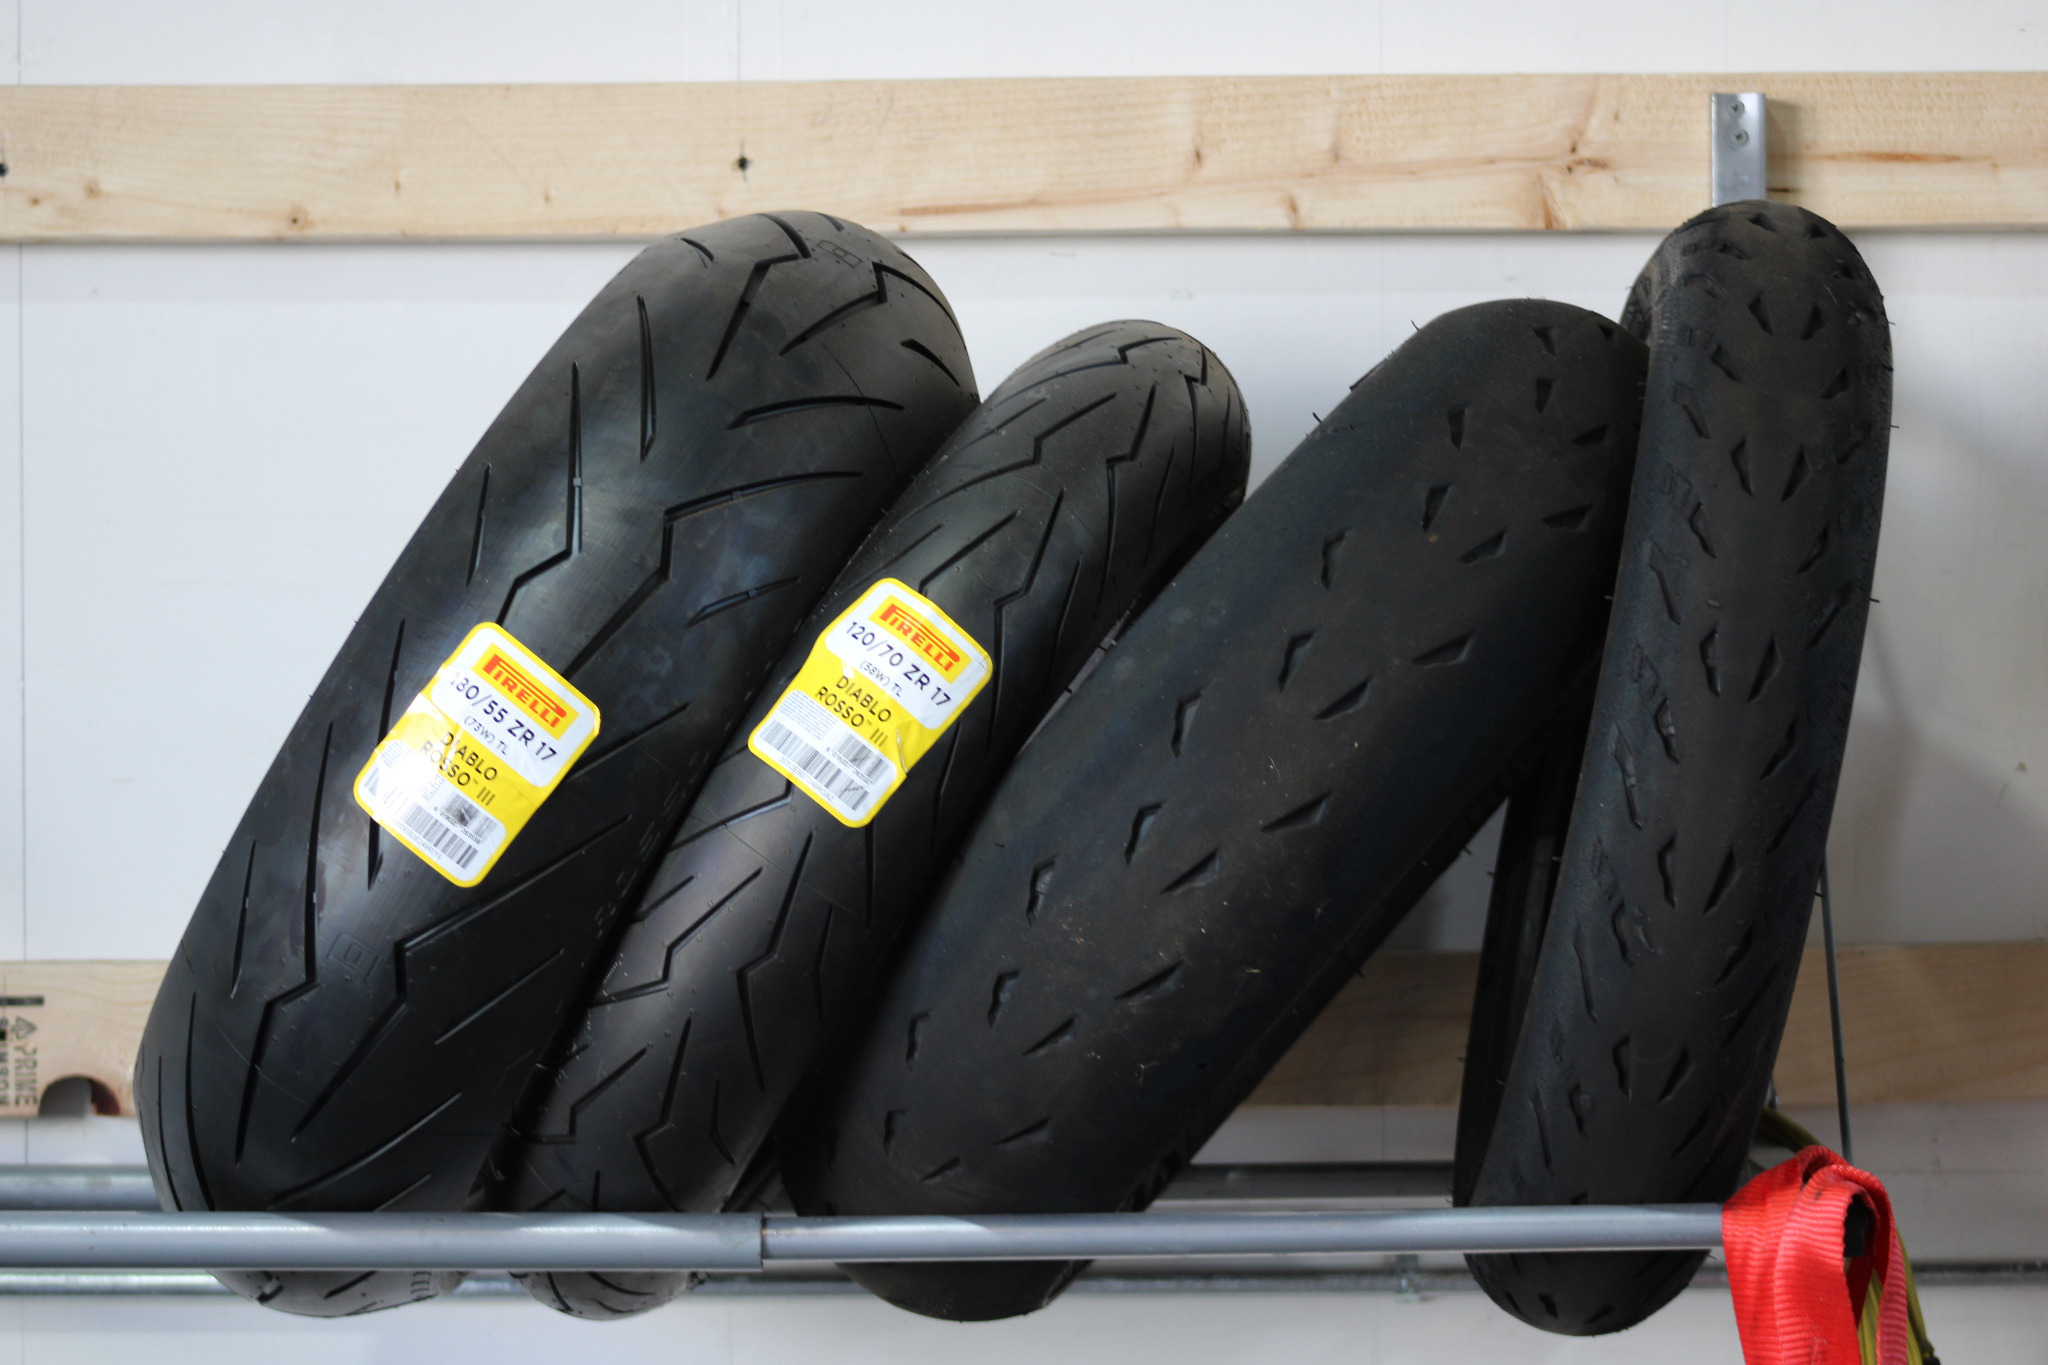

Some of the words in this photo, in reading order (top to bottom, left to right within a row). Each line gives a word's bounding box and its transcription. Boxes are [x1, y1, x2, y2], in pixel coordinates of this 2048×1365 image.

[845, 621, 904, 667] 120/70
[903, 663, 931, 692] ZR
[930, 686, 952, 708] 17
[879, 603, 960, 672] PIRELLI
[482, 654, 567, 728] PIRELLI
[835, 675, 892, 723] DIABLO
[439, 731, 498, 782] DIABLO
[507, 719, 536, 748] ZR
[535, 741, 558, 763] 17
